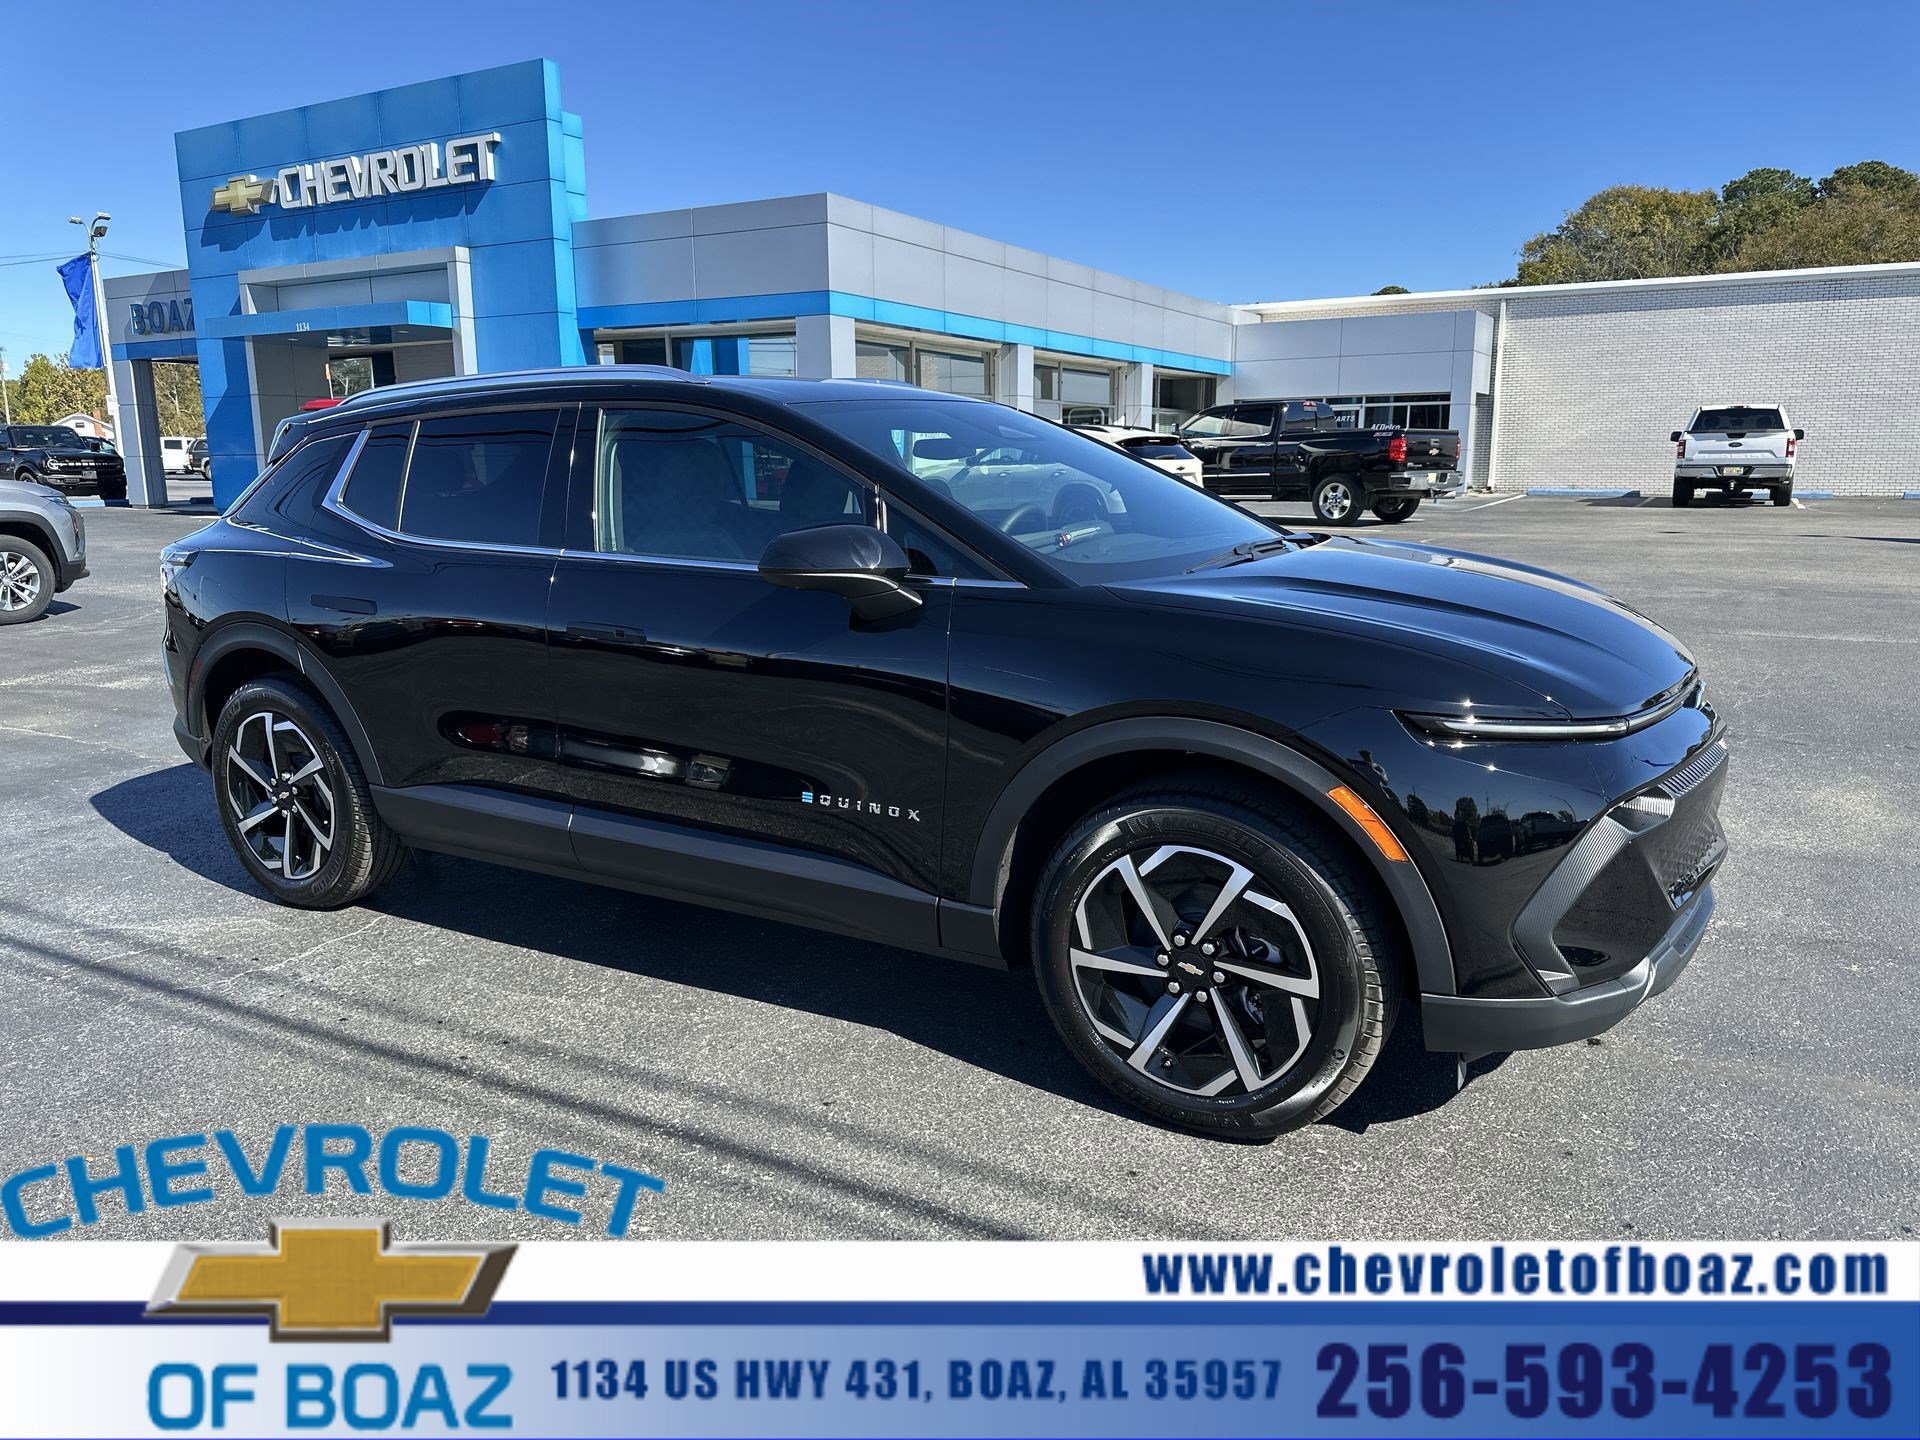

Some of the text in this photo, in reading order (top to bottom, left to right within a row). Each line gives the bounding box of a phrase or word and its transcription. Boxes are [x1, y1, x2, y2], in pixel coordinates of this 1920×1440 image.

[277, 132, 500, 209] CHEVROLET
[295, 322, 310, 332] 1134
[801, 791, 920, 822] EQUINOX
